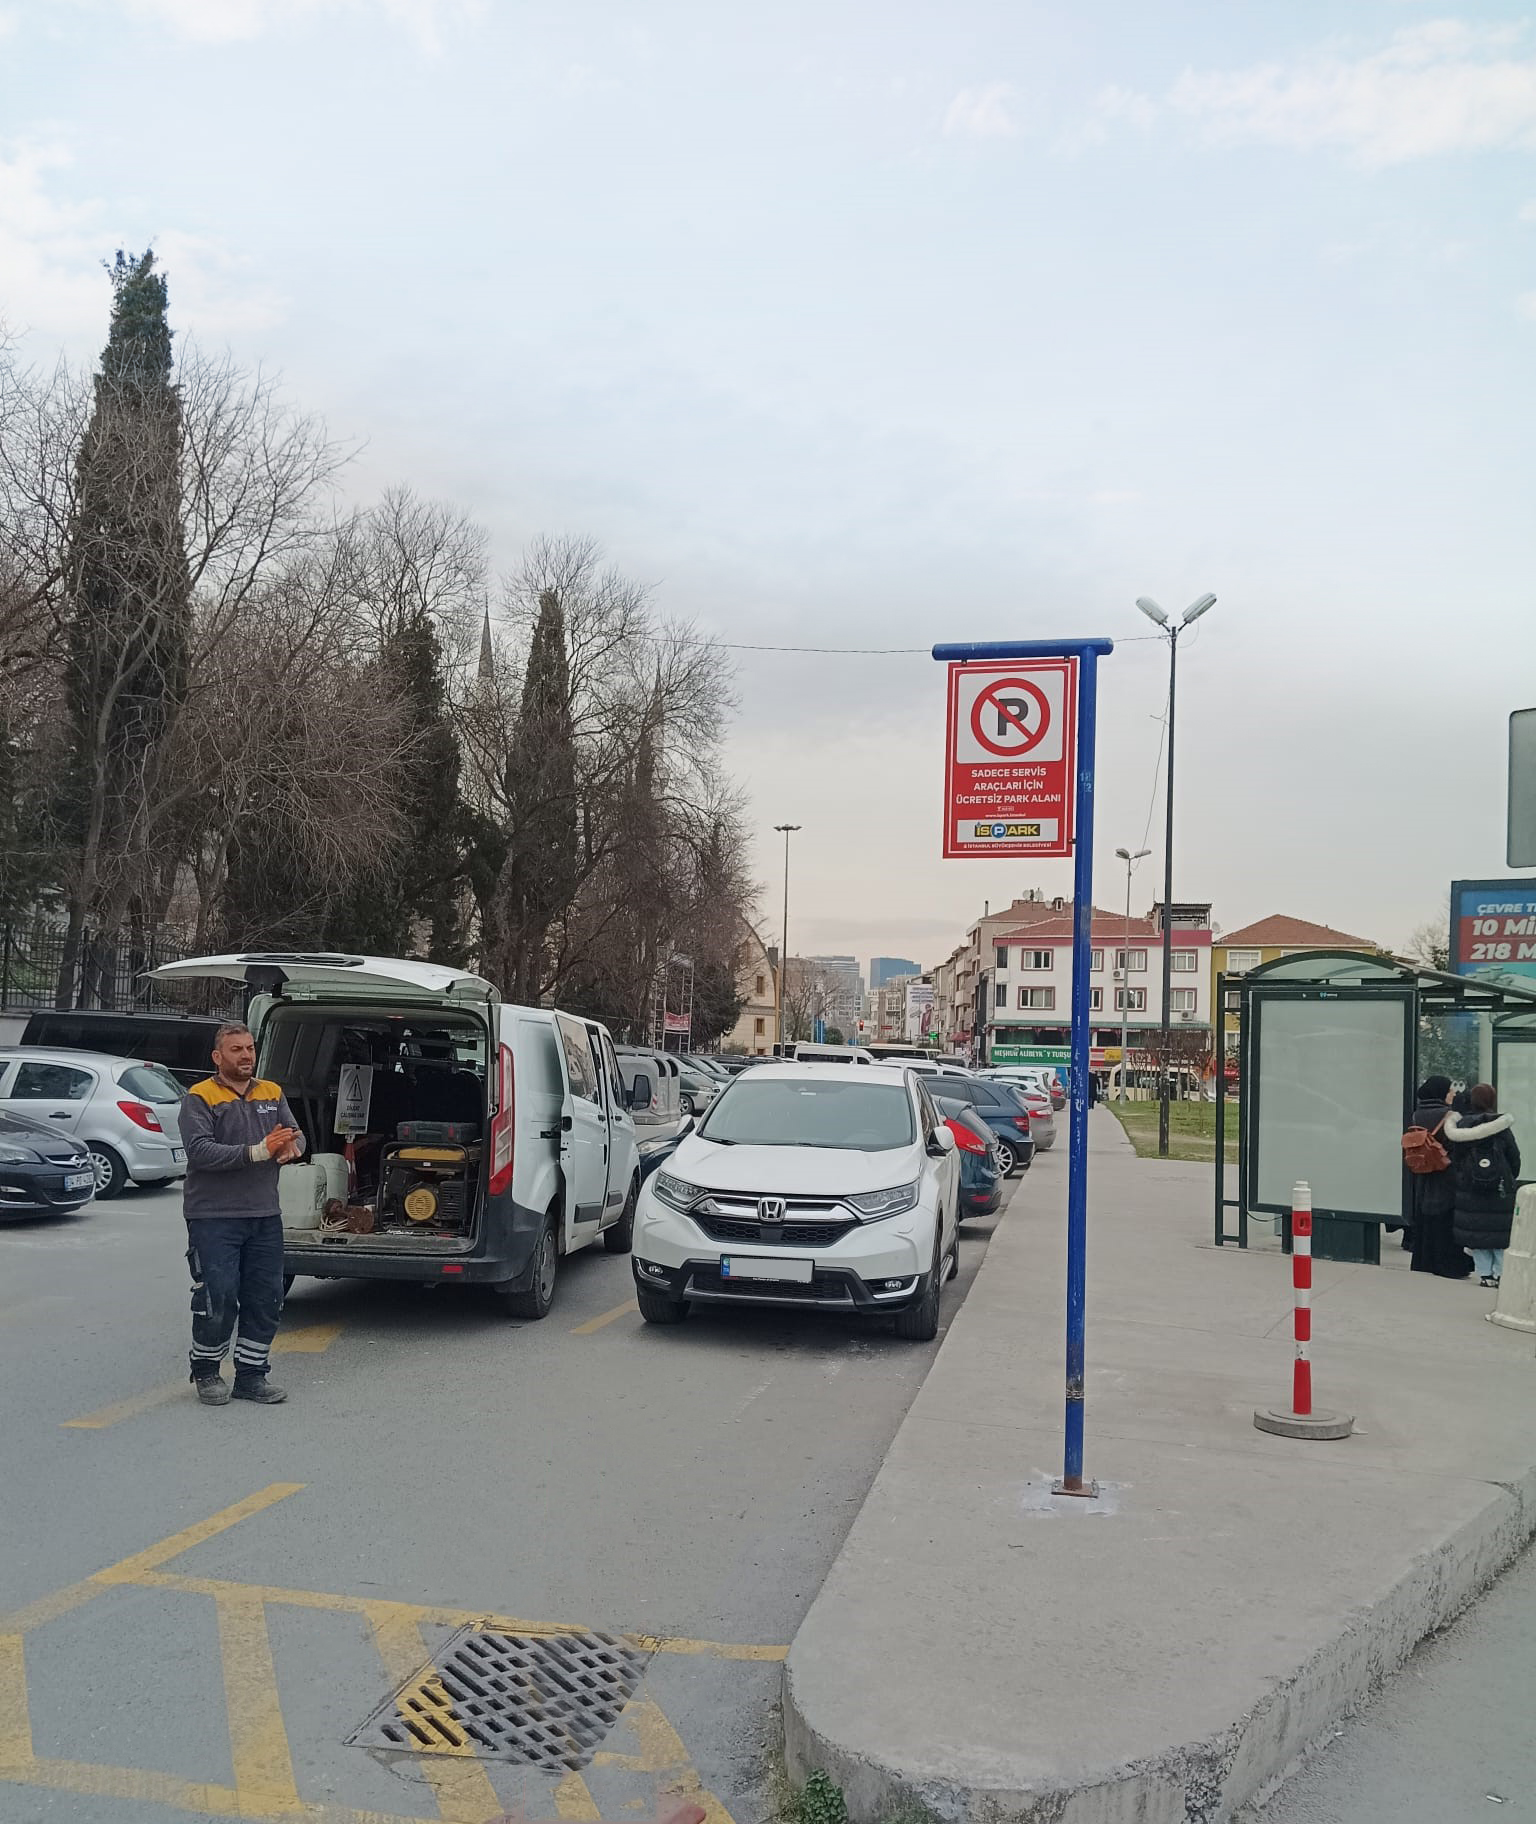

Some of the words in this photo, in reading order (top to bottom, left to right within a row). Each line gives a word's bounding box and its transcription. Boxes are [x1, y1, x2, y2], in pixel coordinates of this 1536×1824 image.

[971, 768, 1011, 778] SADECE
[1012, 766, 1047, 777] SERVİS
[973, 781, 1022, 792] ARAÇLARI
[1023, 779, 1044, 791] İÇİN
[956, 793, 1003, 804] ÜCRETSİZ
[1004, 794, 1029, 803] PARK
[1031, 793, 1061, 803] ALANI
[1477, 903, 1523, 917] ÇEVRE
[1472, 918, 1499, 936] 10
[1470, 942, 1512, 960] 218
